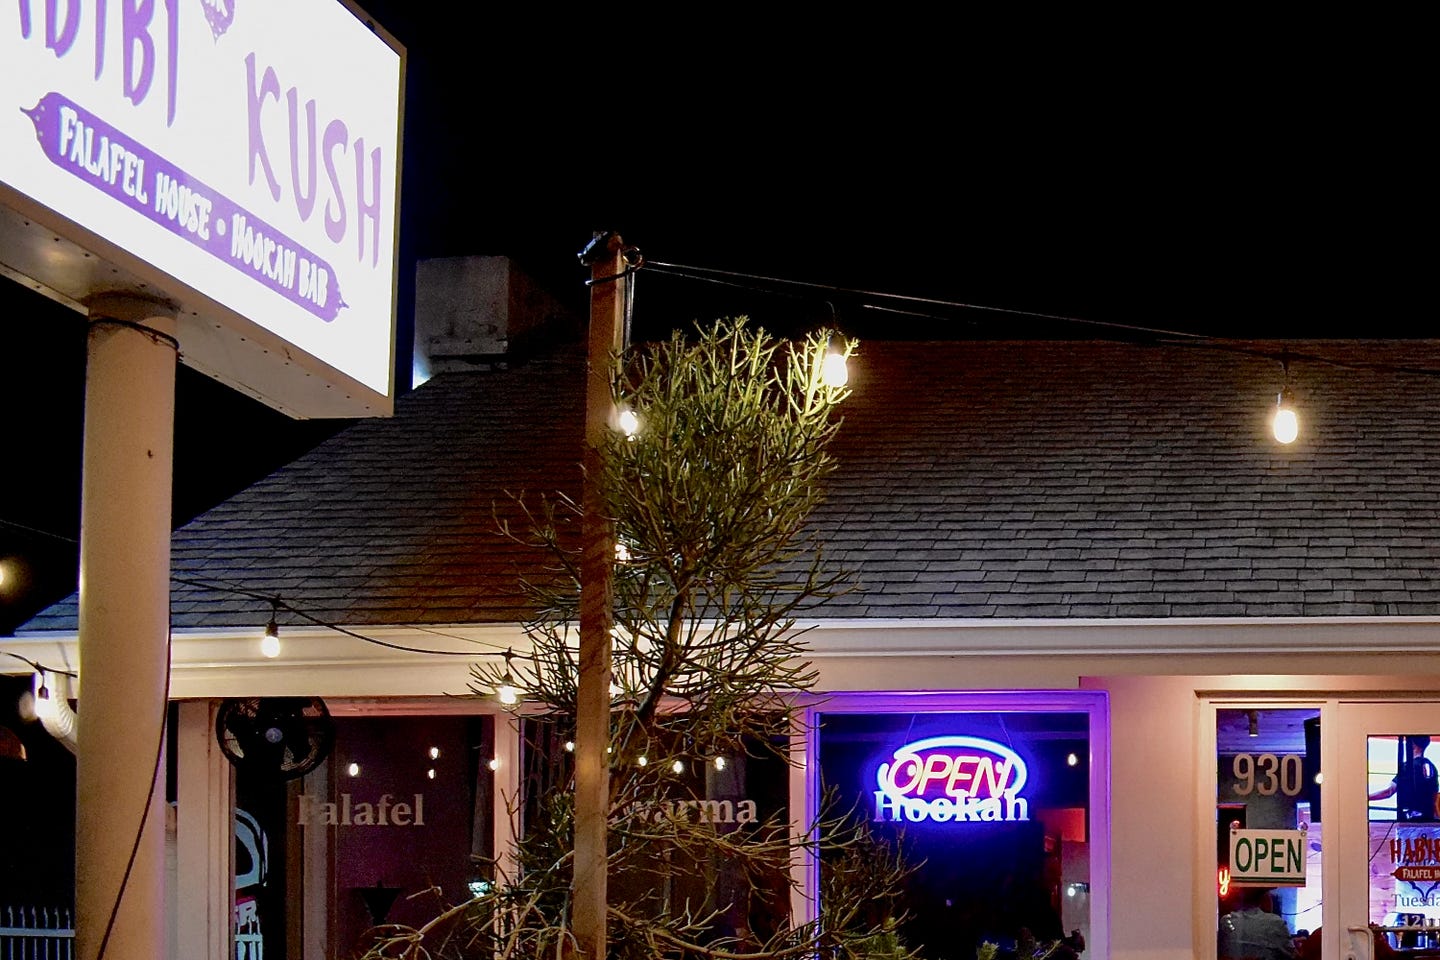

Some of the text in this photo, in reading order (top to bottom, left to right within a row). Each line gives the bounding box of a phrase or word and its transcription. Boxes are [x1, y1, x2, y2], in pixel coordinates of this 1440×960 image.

[245, 52, 382, 269] KUSH
[60, 106, 329, 308] FALAFEL HOUSE HOOKAH BAR
[887, 752, 1013, 798] OPEN
[1232, 752, 1303, 796] 930
[296, 793, 426, 826] Falafel
[873, 788, 1031, 822] Hookah
[1235, 837, 1303, 873] OPEN
[1402, 868, 1433, 879] FALAFEL
